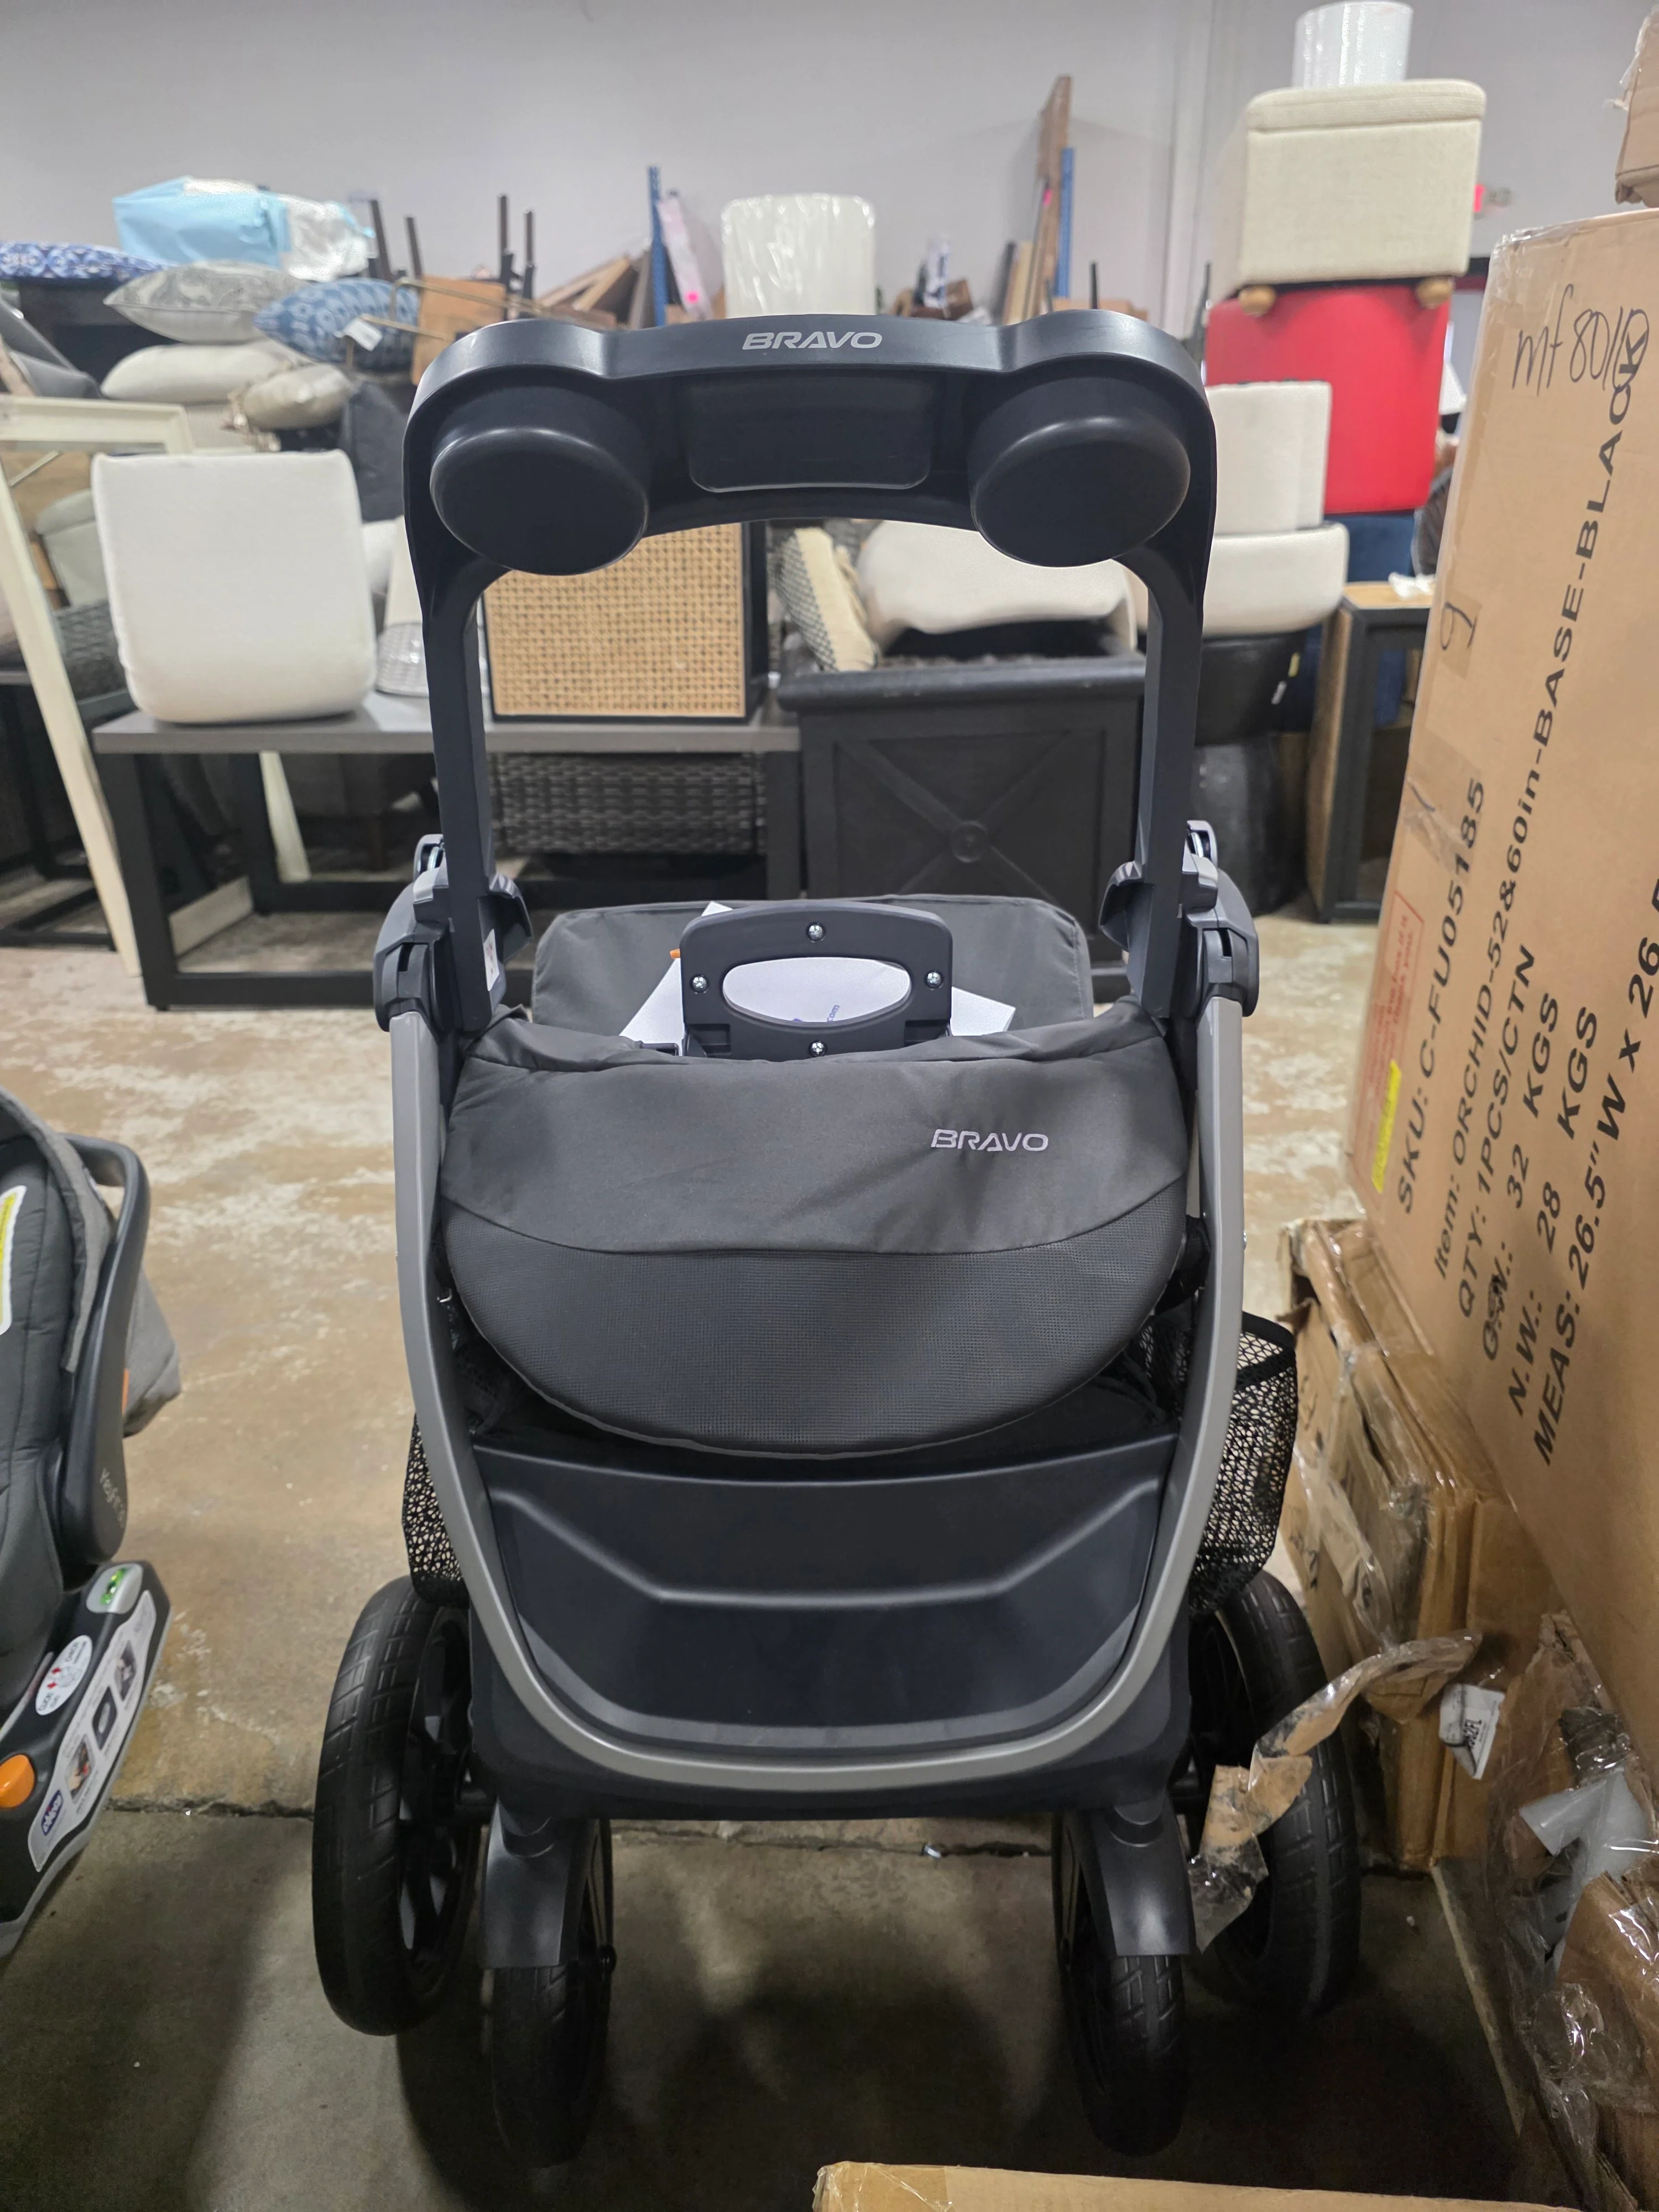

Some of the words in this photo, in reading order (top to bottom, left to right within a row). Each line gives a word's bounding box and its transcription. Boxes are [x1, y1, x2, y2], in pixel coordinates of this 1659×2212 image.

[742, 331, 883, 350] BRAVO
[1434, 1174, 1460, 1280] Item:
[1453, 331, 1648, 1165] ORCHID-52&60in-BASE-BLACK
[931, 1129, 1048, 1152] BRAVO
[1398, 1087, 1428, 1214] SKU:
[1420, 778, 1484, 1078] C-FU05185
[1459, 1205, 1486, 1318] QTY:
[1478, 943, 1535, 1194] 1PCS/CTN
[1507, 1144, 1529, 1209] 32
[1522, 993, 1558, 1119] KGS
[1508, 1290, 1542, 1418] N.W.:
[1537, 1181, 1561, 1254] 28
[1557, 1006, 1597, 1140] KGS
[1533, 1290, 1580, 1467] MEAS:
